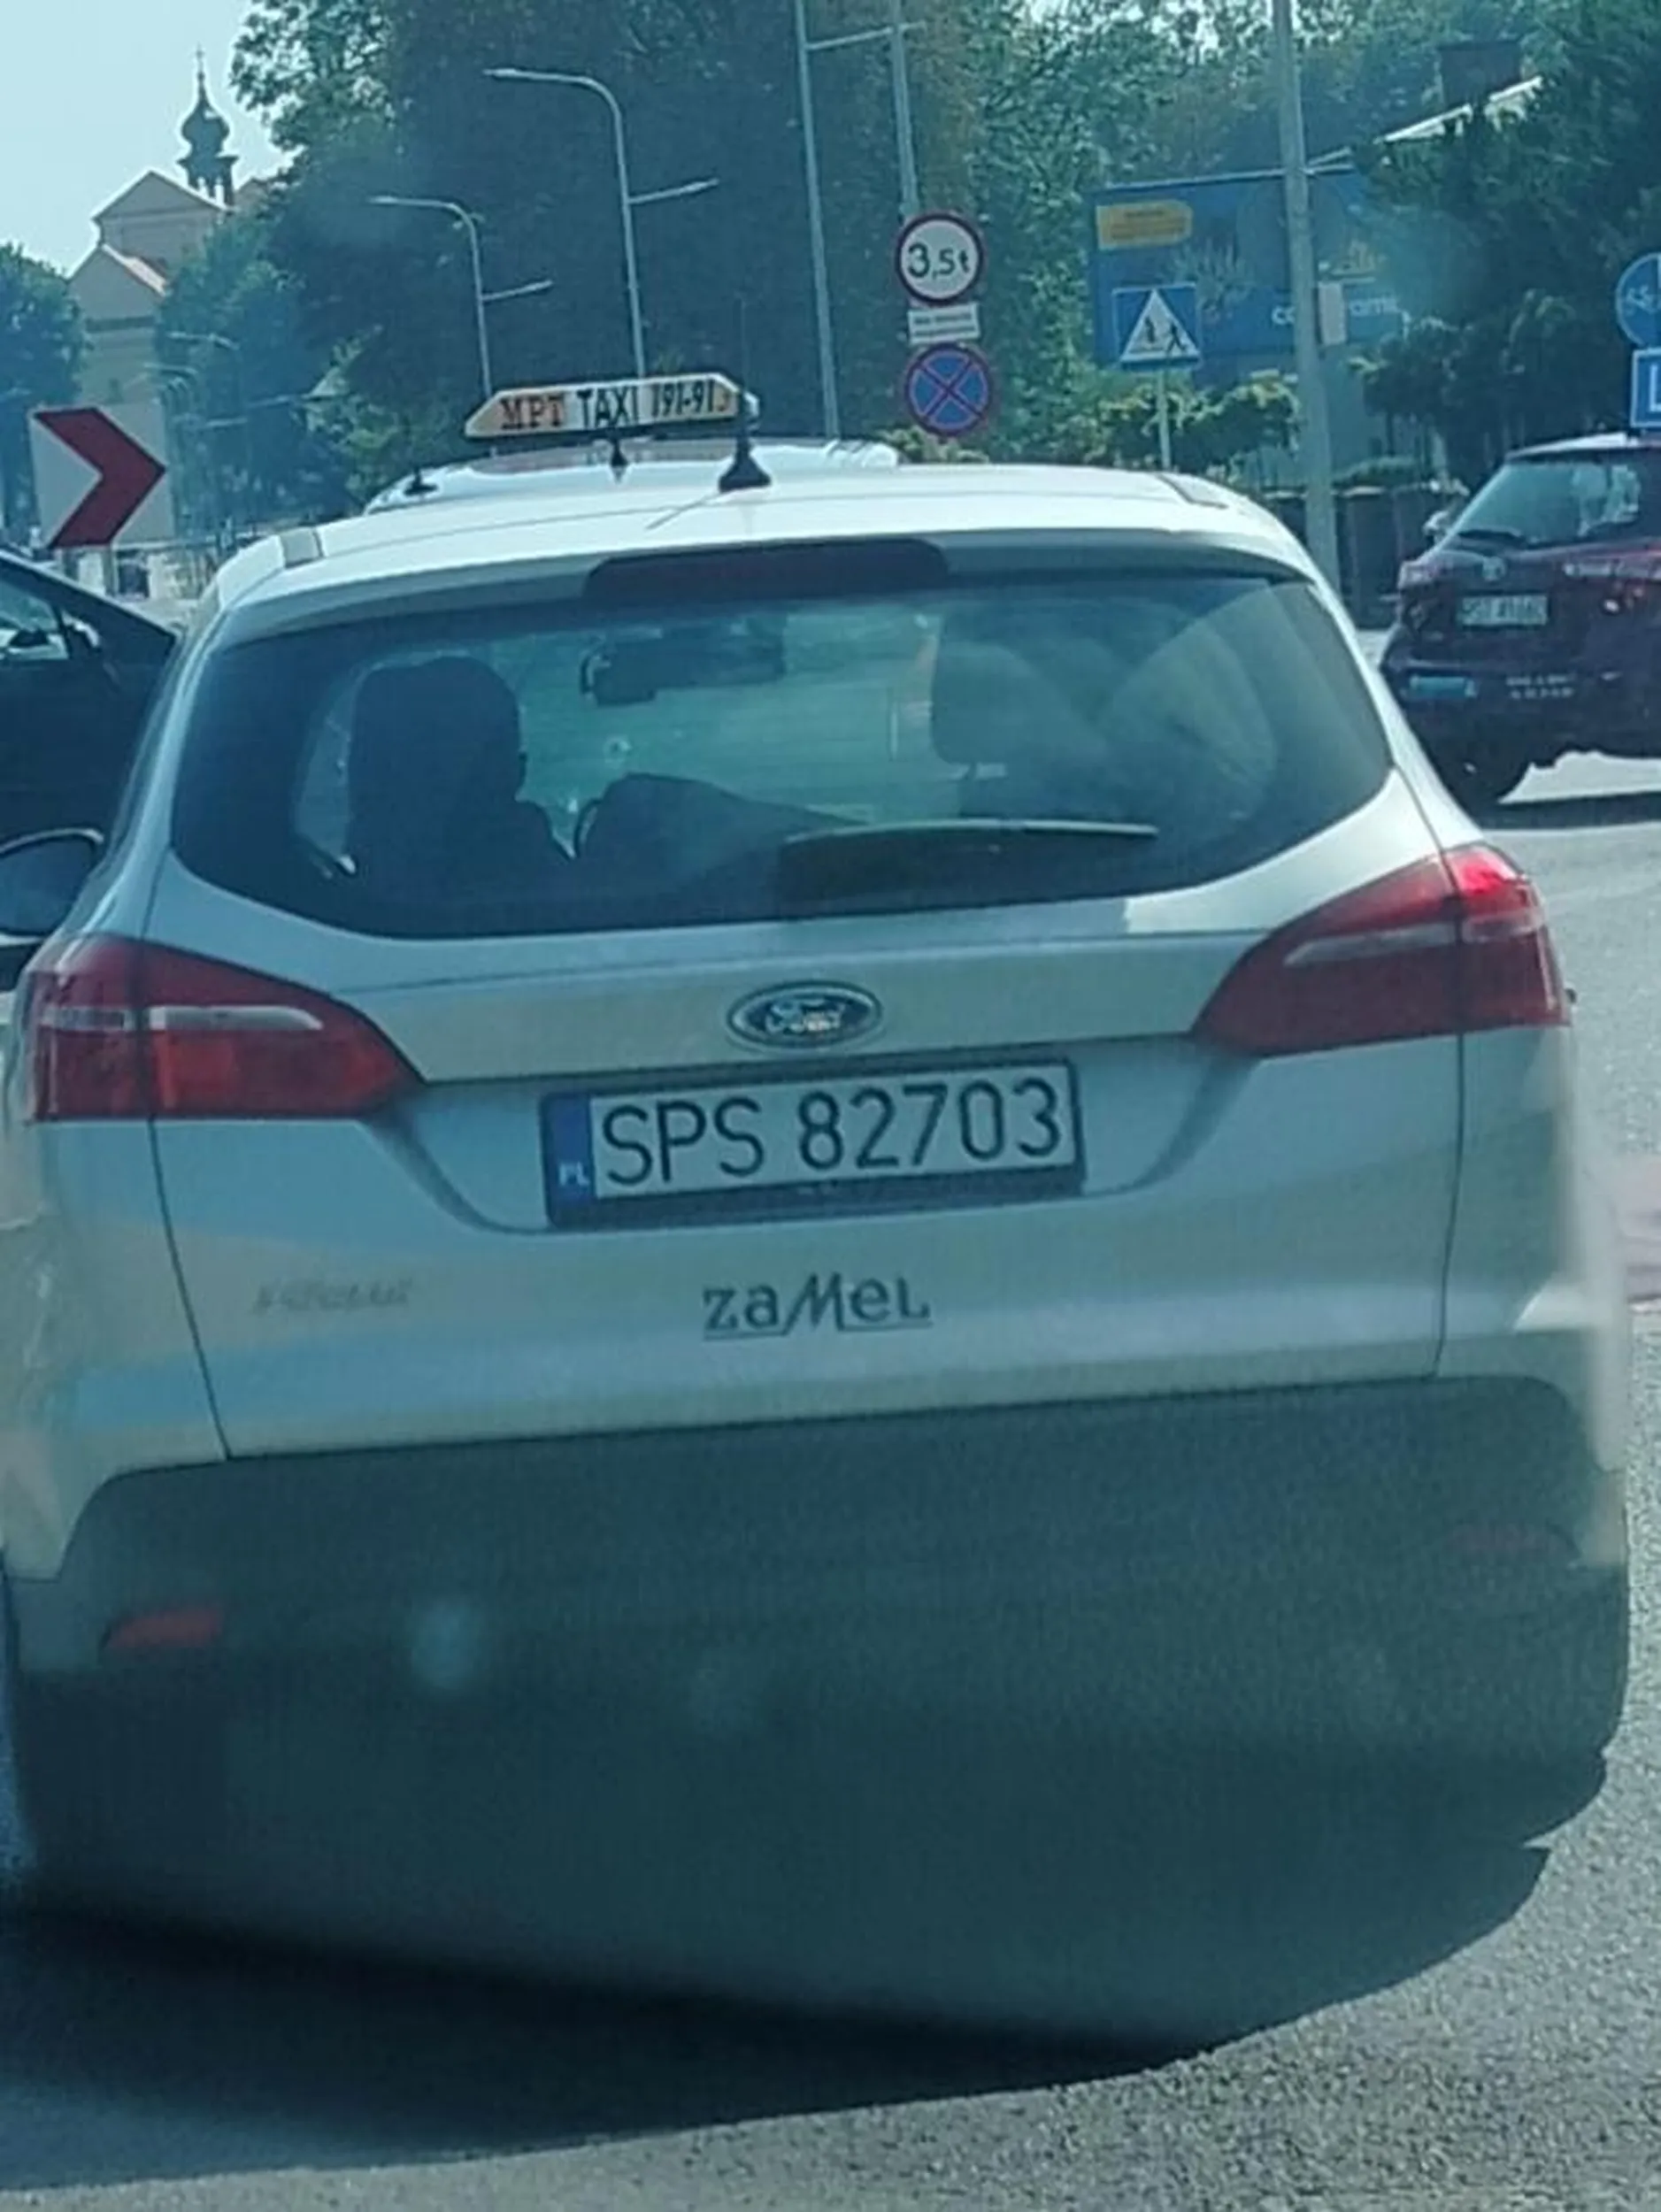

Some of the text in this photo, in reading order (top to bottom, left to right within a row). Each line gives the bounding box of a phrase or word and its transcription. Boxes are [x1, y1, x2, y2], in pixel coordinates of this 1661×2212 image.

[907, 242, 970, 280] 3,5t
[500, 393, 565, 430] MPT
[576, 387, 639, 429] TAXI
[602, 1077, 1061, 1186] SPS 82703
[558, 1162, 591, 1186] PL
